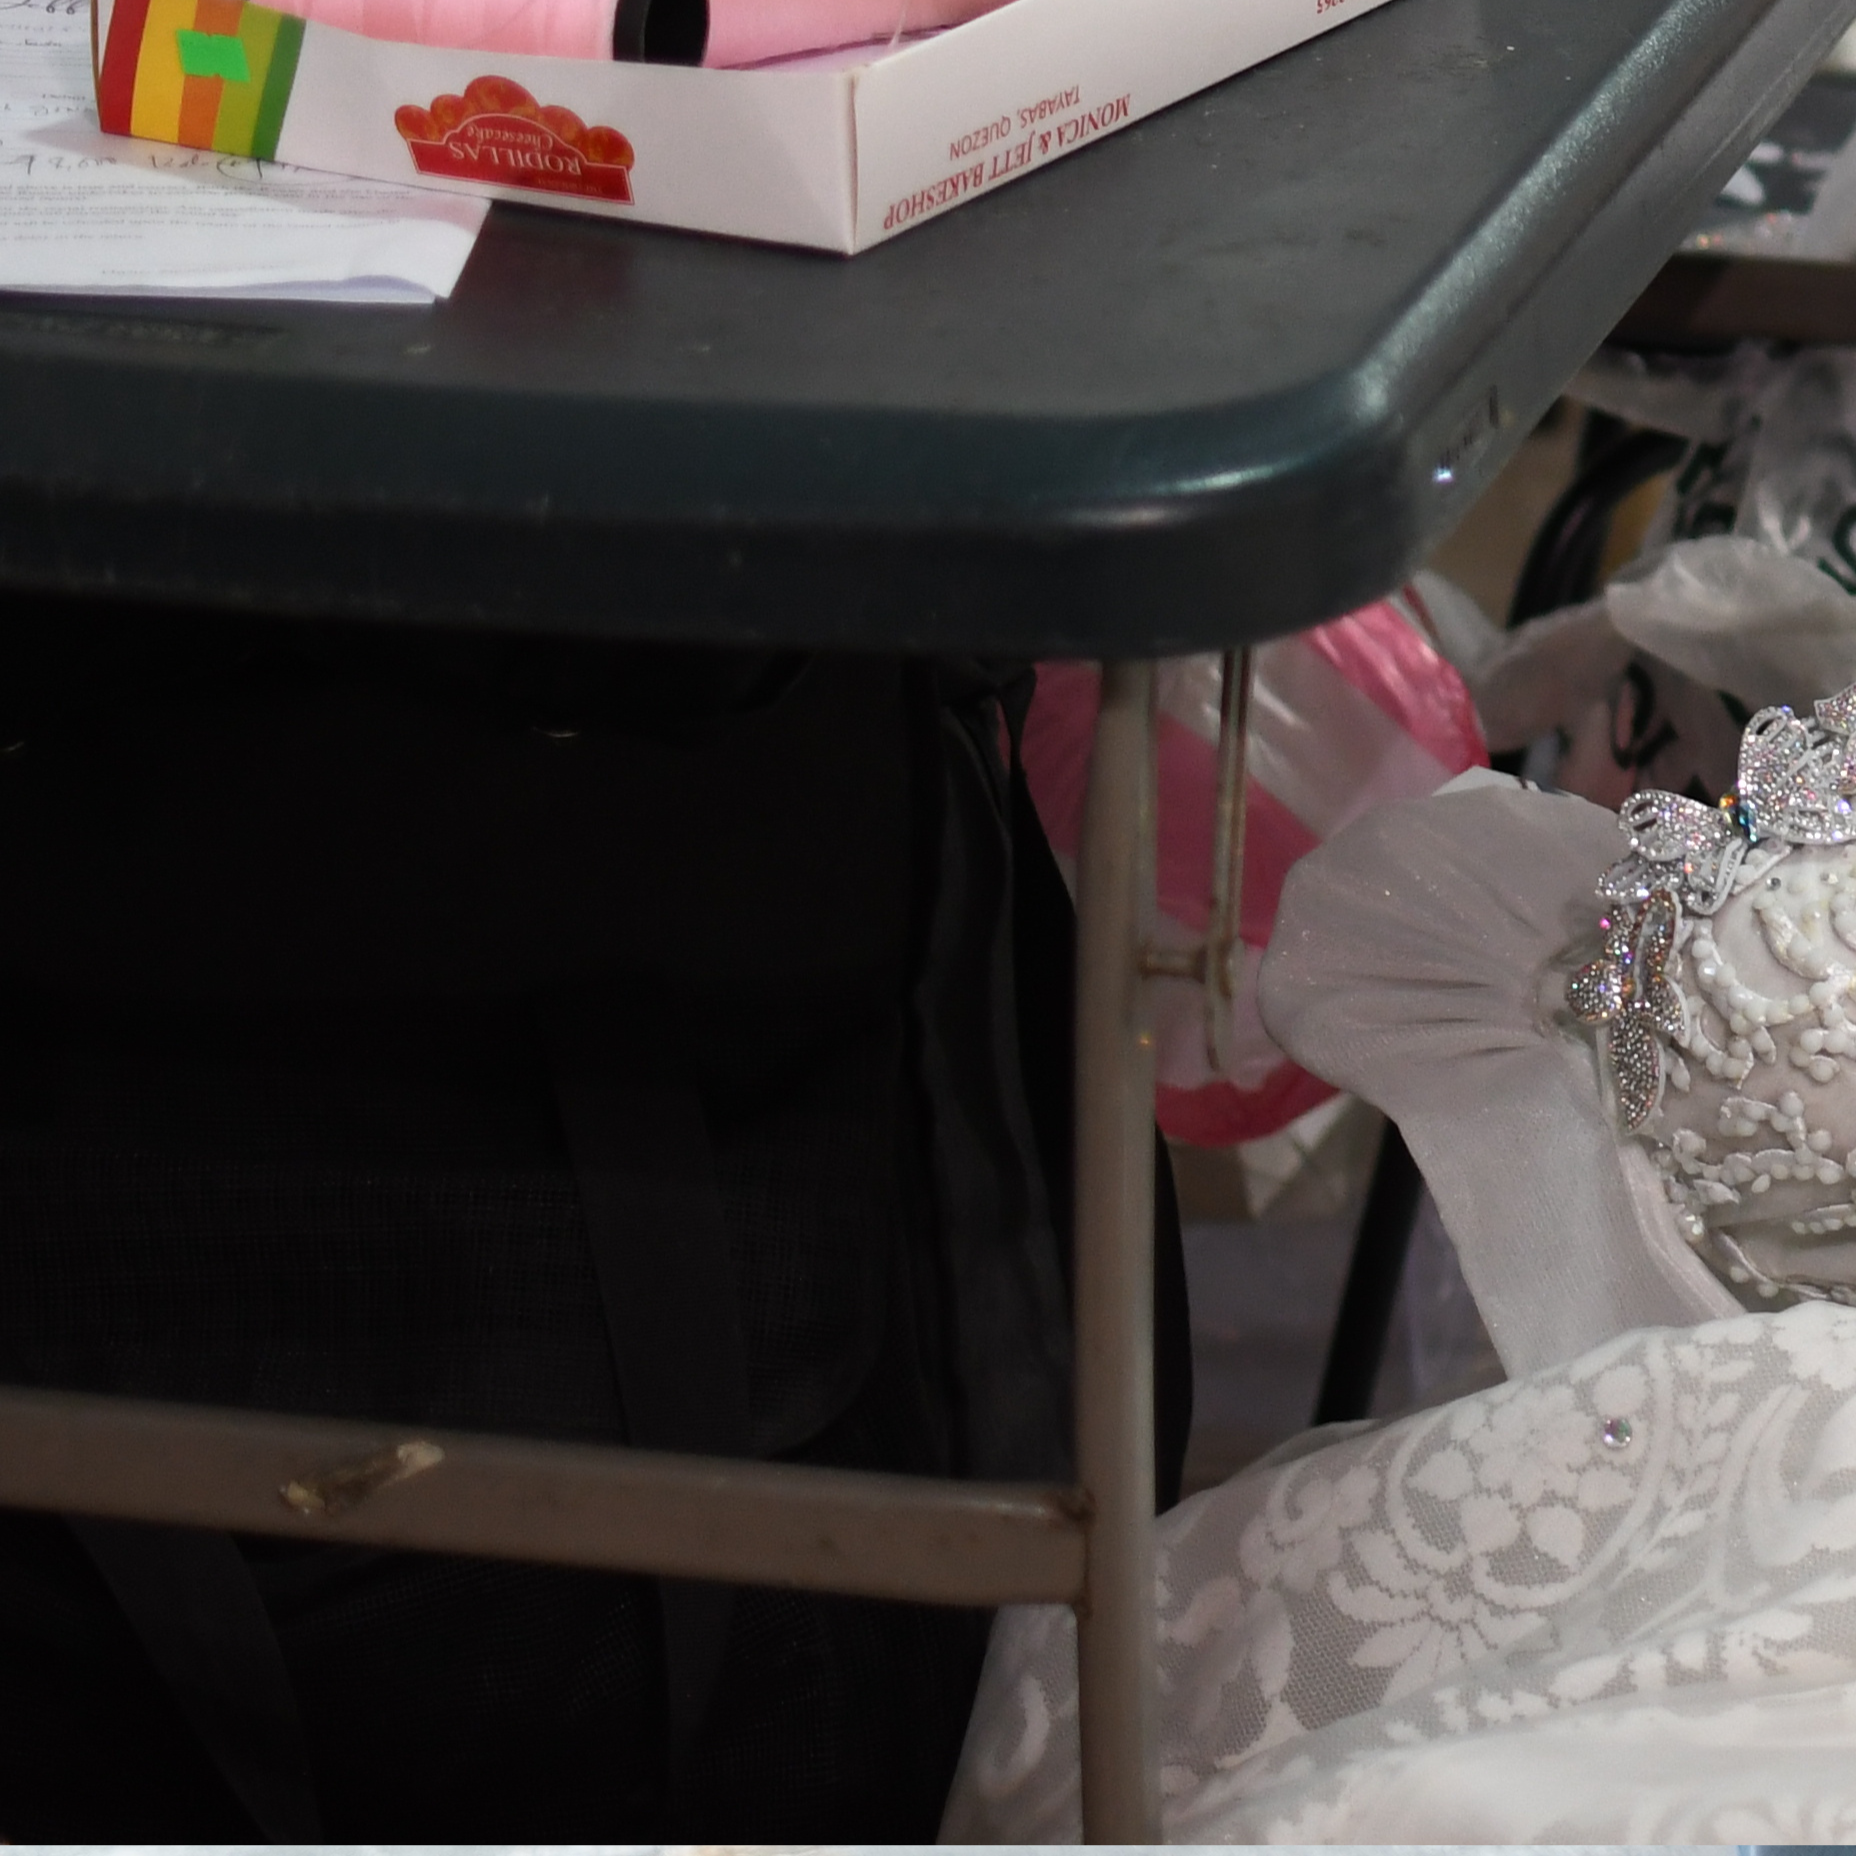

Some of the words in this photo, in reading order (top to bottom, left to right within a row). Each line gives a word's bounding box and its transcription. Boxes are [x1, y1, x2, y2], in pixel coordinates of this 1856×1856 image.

[1017, 84, 1080, 129] TAYABAS,
[1057, 93, 1131, 147] MONICA
[449, 141, 582, 176] RODILLAS
[466, 124, 555, 151] Cheesecake
[950, 115, 1011, 161] QUEZON
[988, 130, 1036, 181] JETT
[1038, 130, 1052, 155] &
[884, 162, 985, 230] BAKESHOP
